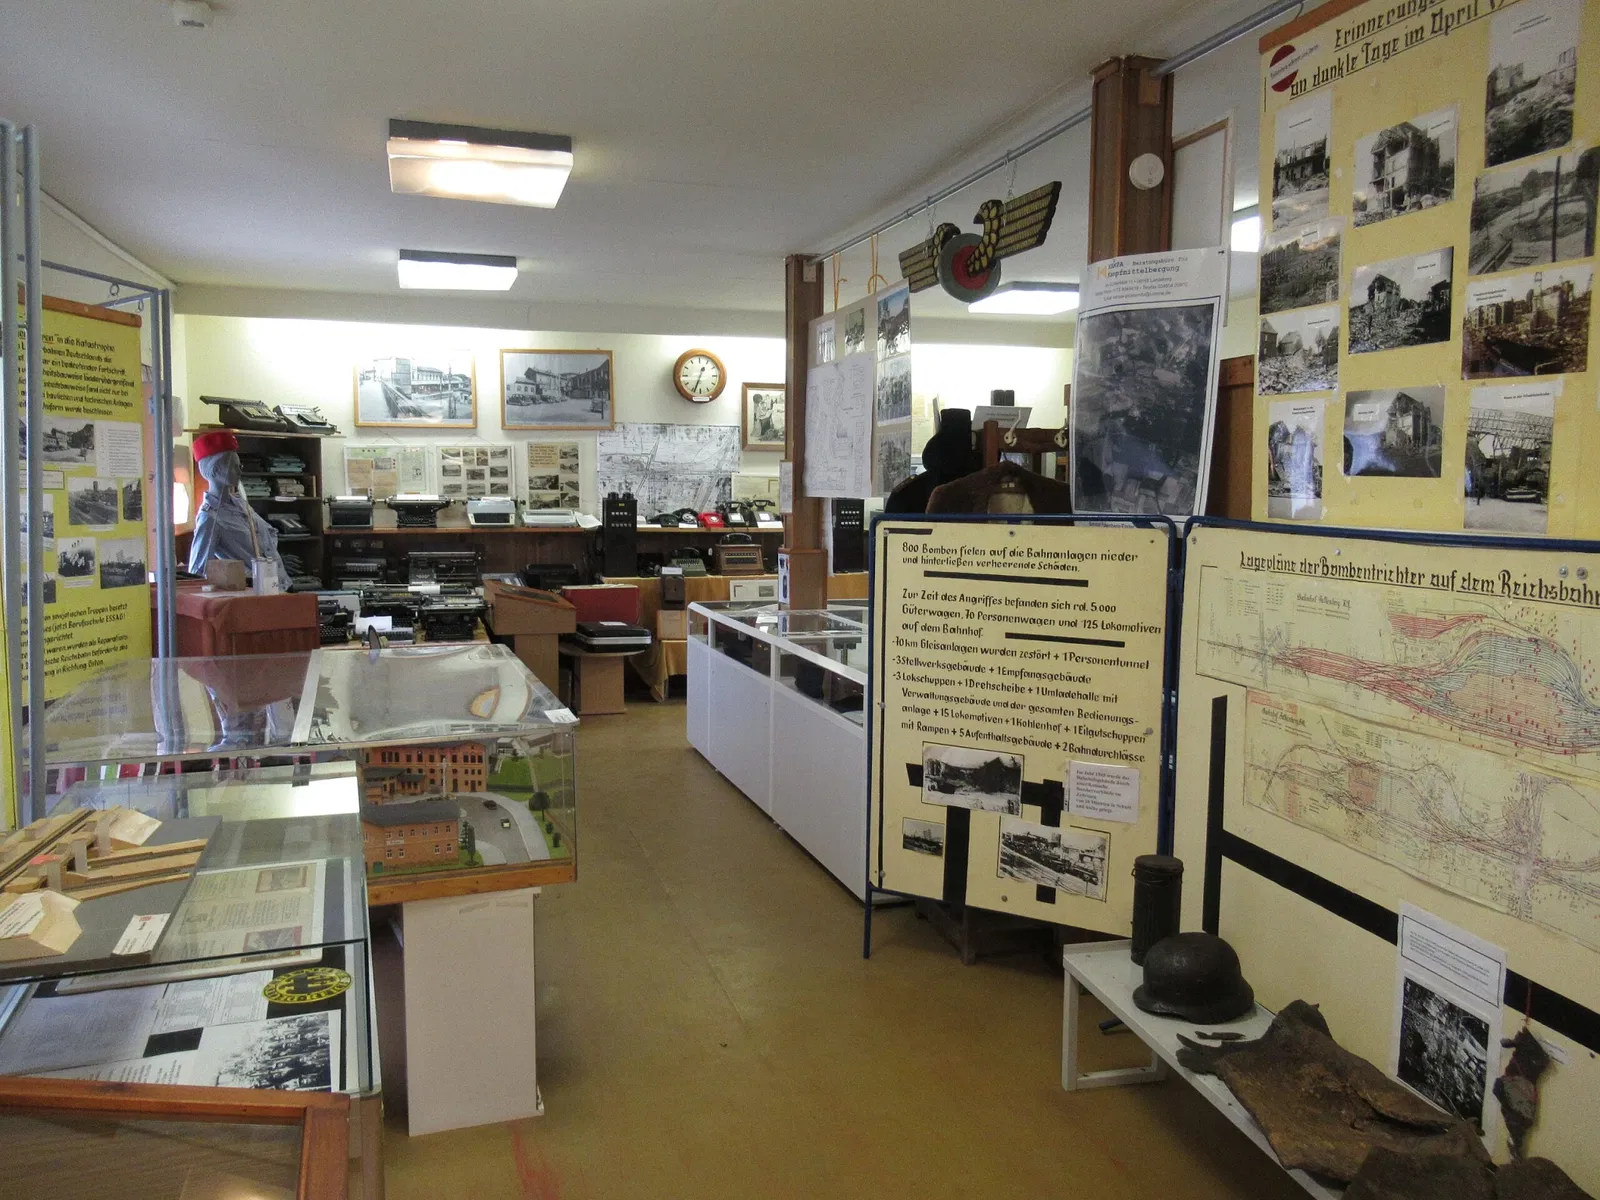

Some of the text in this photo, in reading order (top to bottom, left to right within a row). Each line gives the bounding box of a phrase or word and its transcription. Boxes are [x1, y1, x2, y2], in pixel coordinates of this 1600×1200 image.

[1312, 53, 1358, 87] dunkle
[1361, 36, 1399, 63] Tage
[1404, 25, 1425, 48] im
[1430, 0, 1479, 36] April
[902, 541, 1139, 562] 800 Bomben fielen auf die Bahnanlagen nieder
[902, 556, 918, 564] und
[921, 556, 973, 568] hinterließen
[976, 559, 1036, 570] verheerende
[1240, 551, 1296, 573] Lagepläne
[1320, 556, 1425, 585] Bombentrichter
[1430, 570, 1457, 592] auf
[1460, 572, 1495, 594] dem
[902, 588, 919, 599] Zur
[920, 590, 939, 601] Zeit
[941, 592, 957, 602] des
[959, 593, 1002, 607] Angriffes
[1004, 597, 1048, 609] befanden
[1051, 599, 1071, 610] sich
[902, 621, 919, 633] auf
[920, 623, 940, 632] dem
[977, 611, 1055, 627] Personenwagen
[1058, 619, 1078, 628] und
[1081, 619, 1098, 629] 125
[1101, 620, 1161, 634] Lokomotiven
[920, 639, 978, 654] Gleisanlagen
[980, 647, 1017, 657] wurden
[1019, 649, 1051, 660] zestört
[902, 687, 1139, 726] Verwaltungsgebäude und der gesamten Bedienungs-
[1102, 693, 1118, 703] mit
[901, 705, 931, 717] anlage
[941, 708, 949, 718] 15
[951, 709, 1003, 724] Lokomotiven
[901, 720, 914, 730] mit
[917, 721, 950, 736] Rampen
